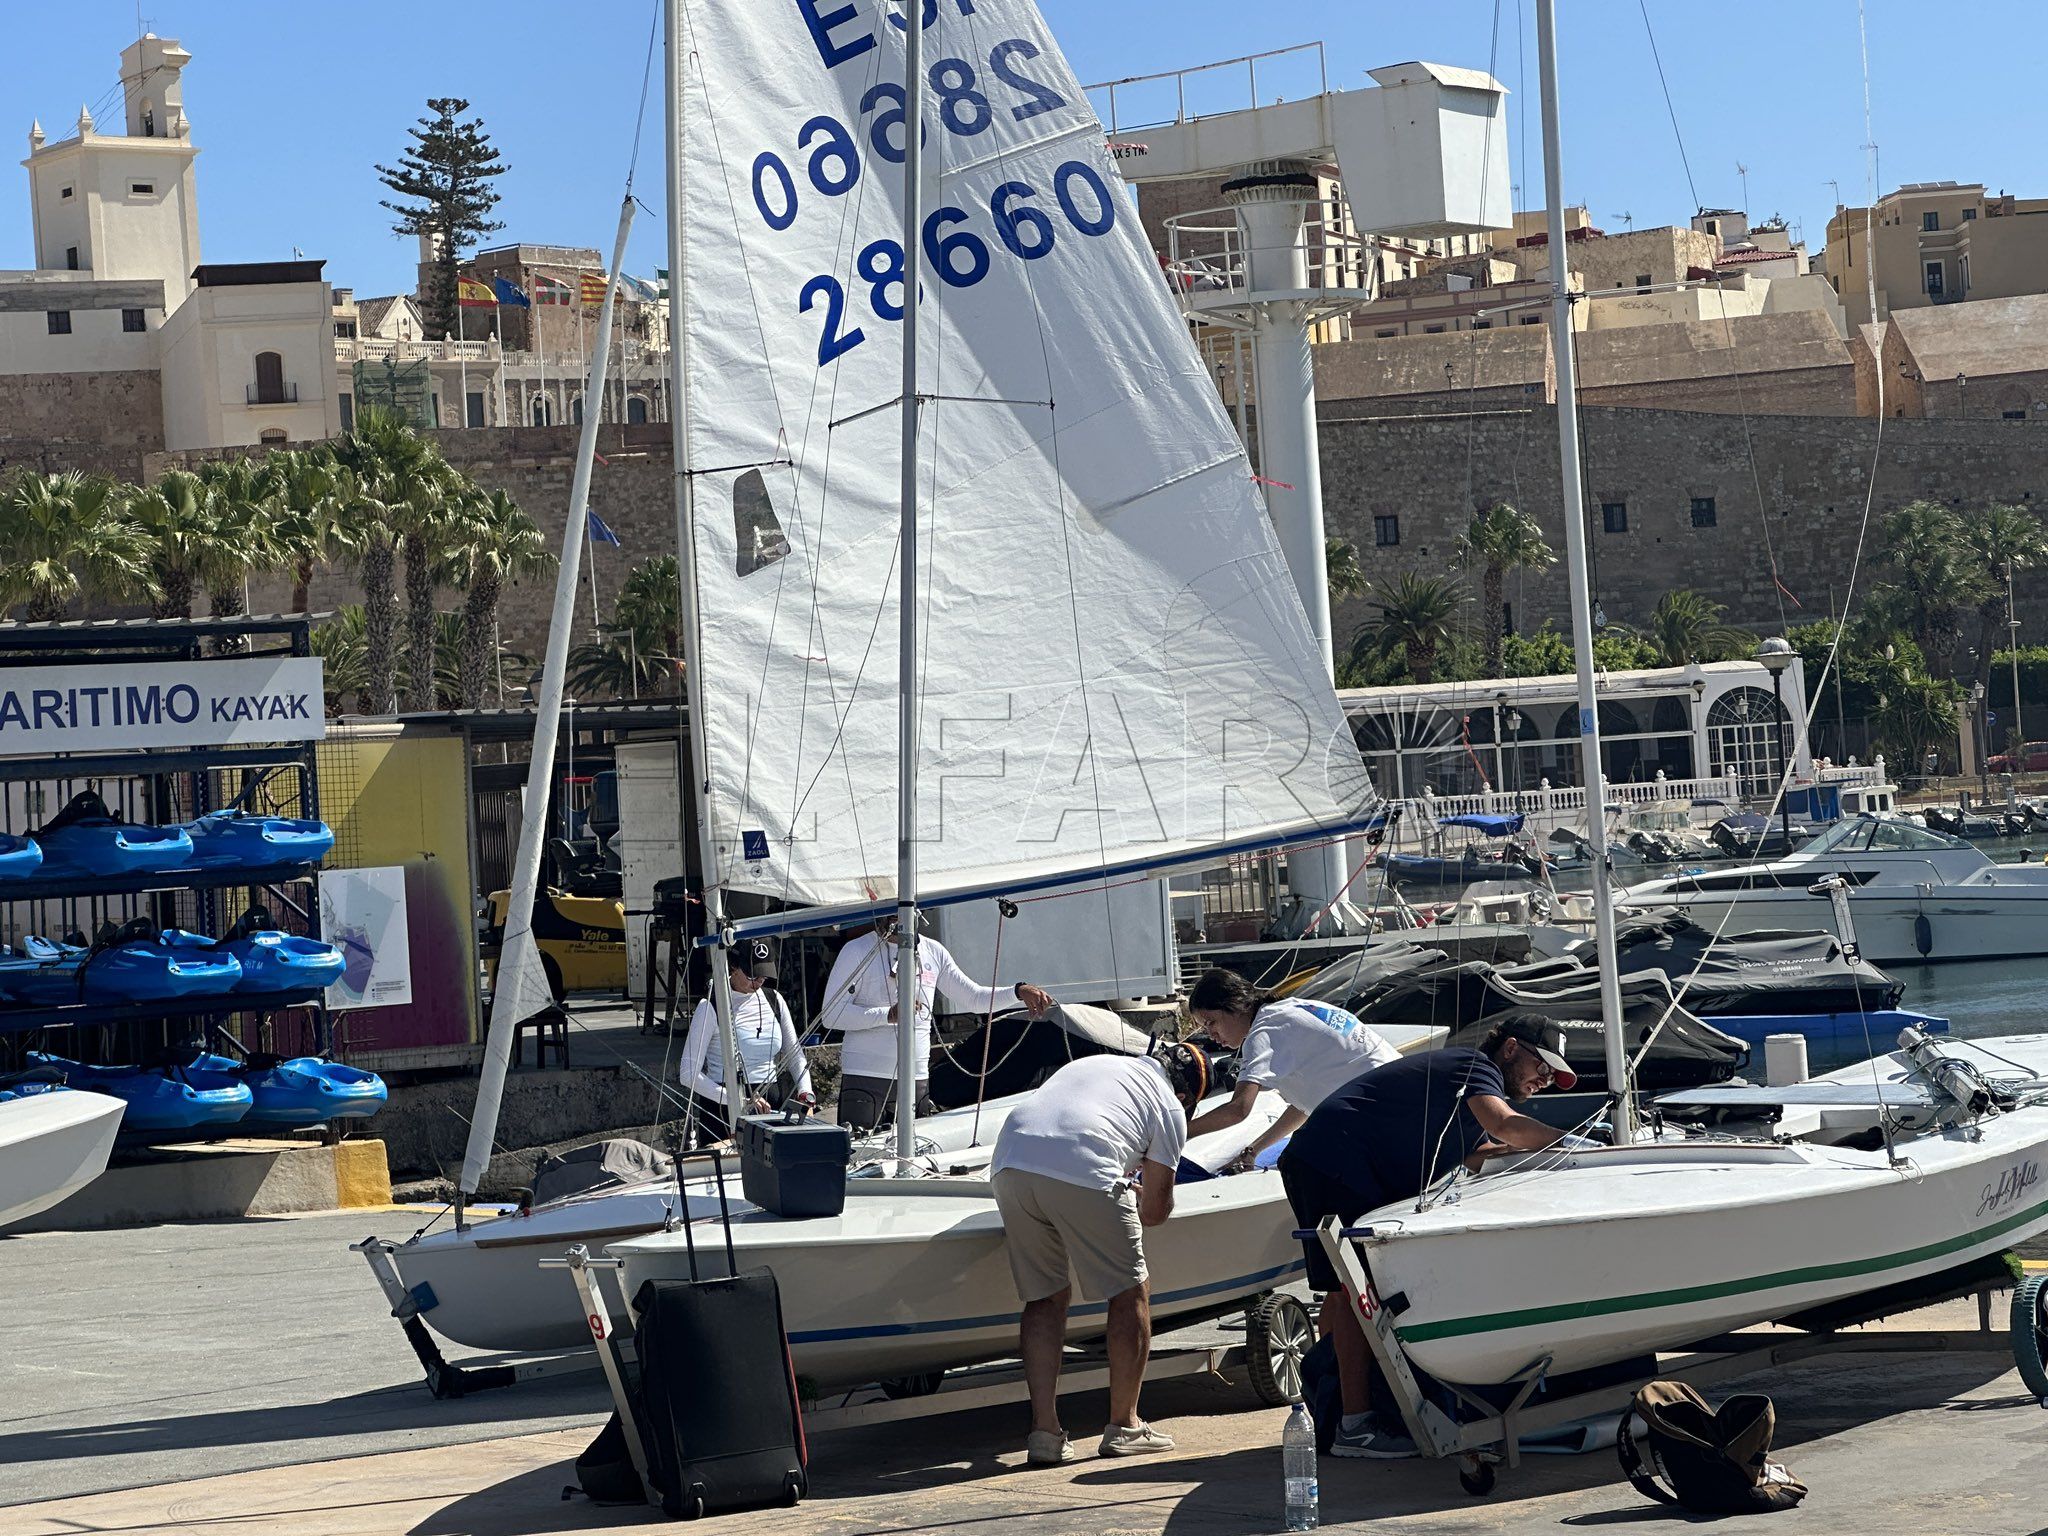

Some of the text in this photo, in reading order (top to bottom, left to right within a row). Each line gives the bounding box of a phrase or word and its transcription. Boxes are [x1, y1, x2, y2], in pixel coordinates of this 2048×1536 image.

[1125, 147, 1131, 158] 5
[799, 160, 1115, 367] 28660
[211, 694, 310, 723] KAYAK
[581, 929, 609, 941] Yale
